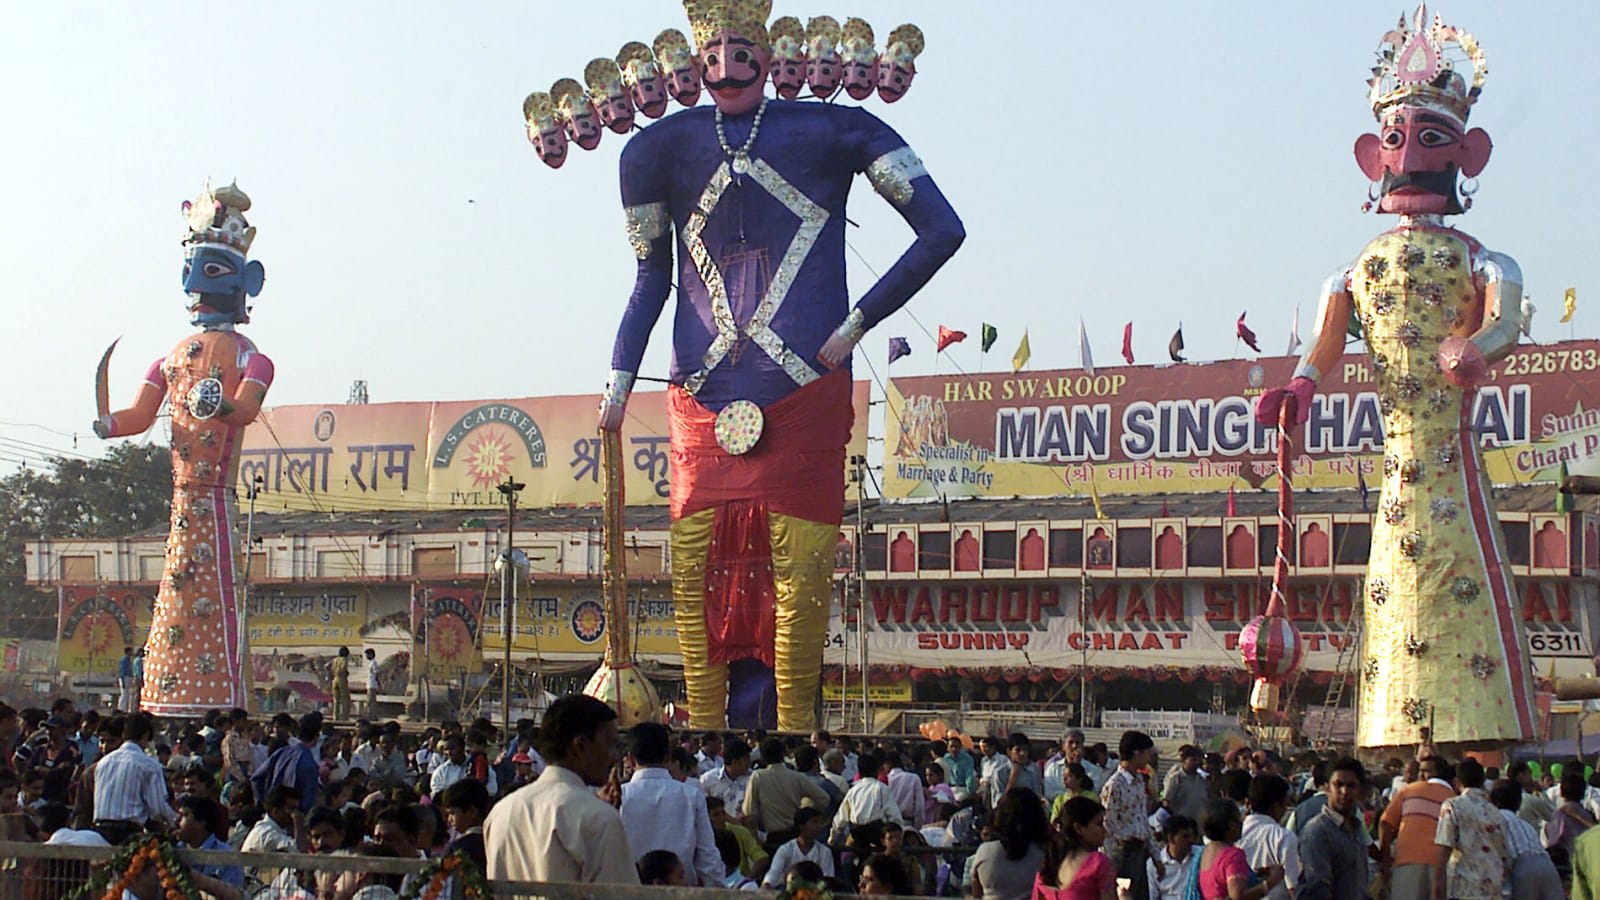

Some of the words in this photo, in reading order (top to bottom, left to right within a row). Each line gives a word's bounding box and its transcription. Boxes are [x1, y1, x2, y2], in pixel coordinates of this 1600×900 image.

[1503, 349, 1600, 376] 2326783
[943, 382, 993, 402] HAR
[1001, 375, 1126, 400] SWAROOP
[995, 404, 1111, 462] MAN
[1541, 408, 1600, 438] Sunn
[919, 441, 972, 462] Specialist
[1516, 440, 1578, 473] Chaat
[240, 446, 333, 493] लाला
[347, 444, 415, 493] राम
[897, 462, 945, 486] Marriage
[948, 466, 958, 481] &
[962, 466, 994, 490] Party
[1188, 457, 1242, 479] लीला
[1078, 582, 1185, 622] MAN
[918, 632, 1029, 650] SUNNY
[1067, 632, 1188, 650] CHAAT
